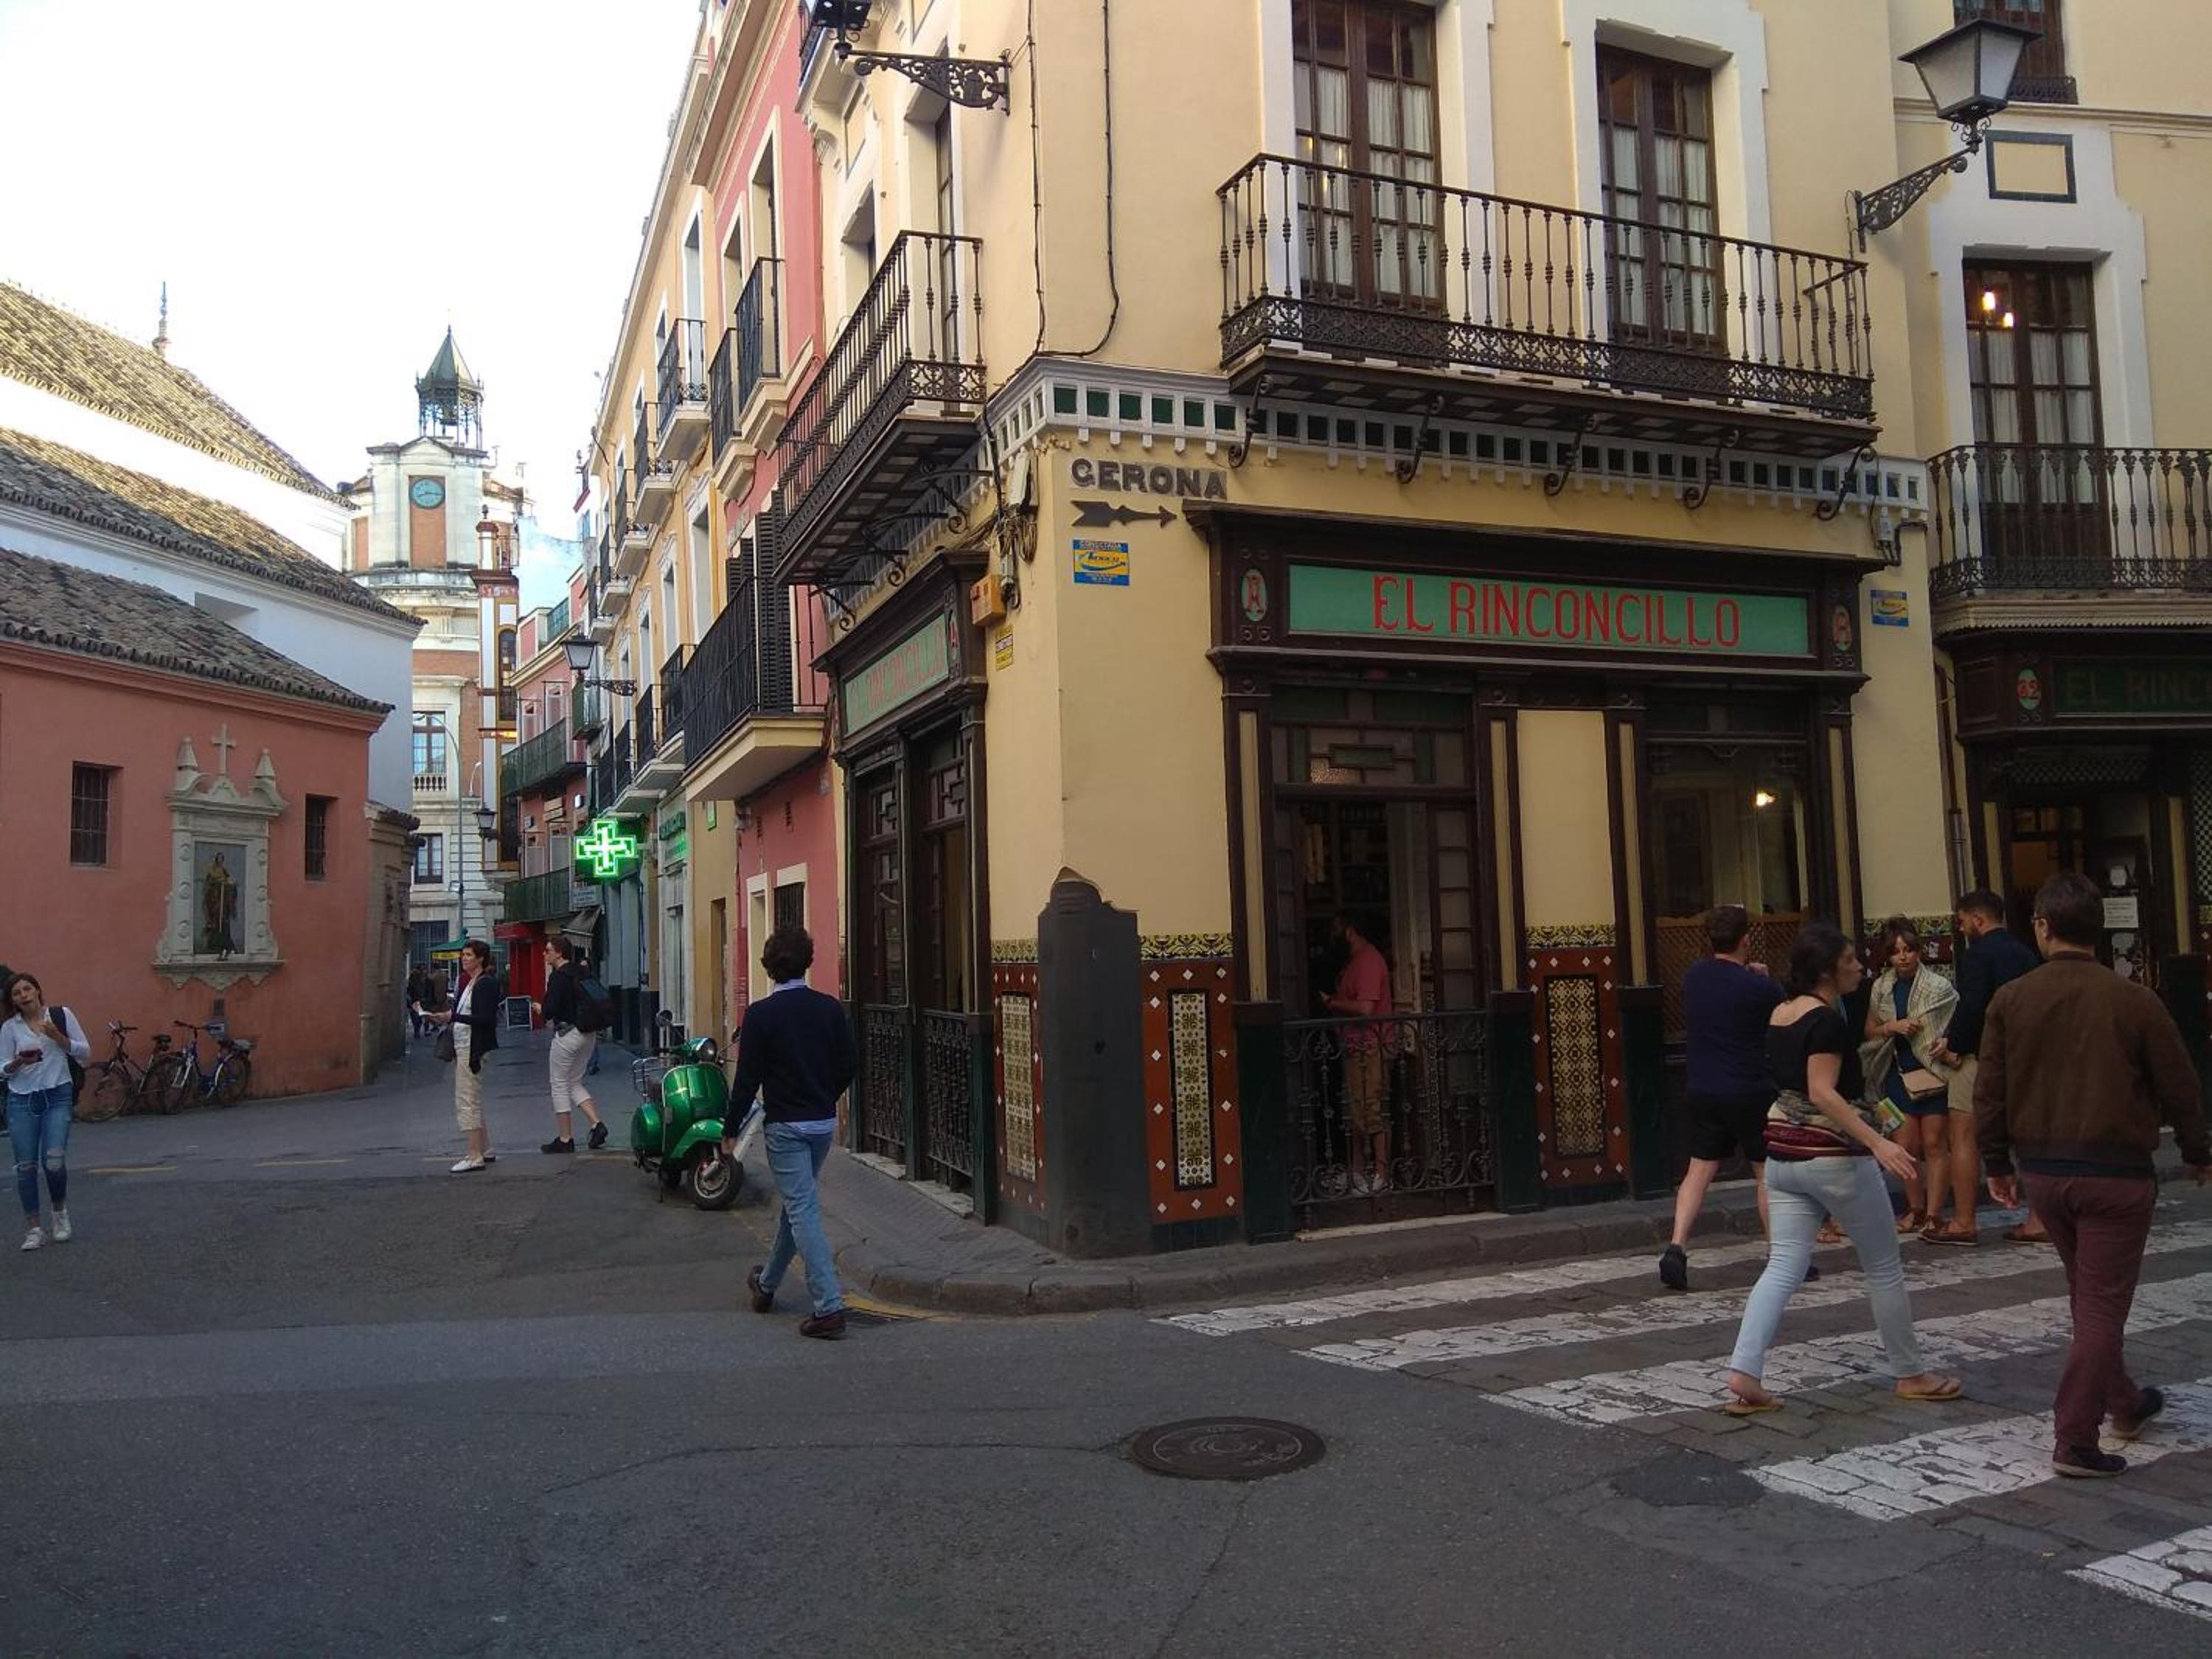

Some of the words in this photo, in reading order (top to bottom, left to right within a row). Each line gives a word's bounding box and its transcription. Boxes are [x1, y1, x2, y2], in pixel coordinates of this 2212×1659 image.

[1072, 458, 1227, 500] GERONA
[1371, 575, 1435, 633] EL
[1447, 580, 1741, 647] RINCONCILLO
